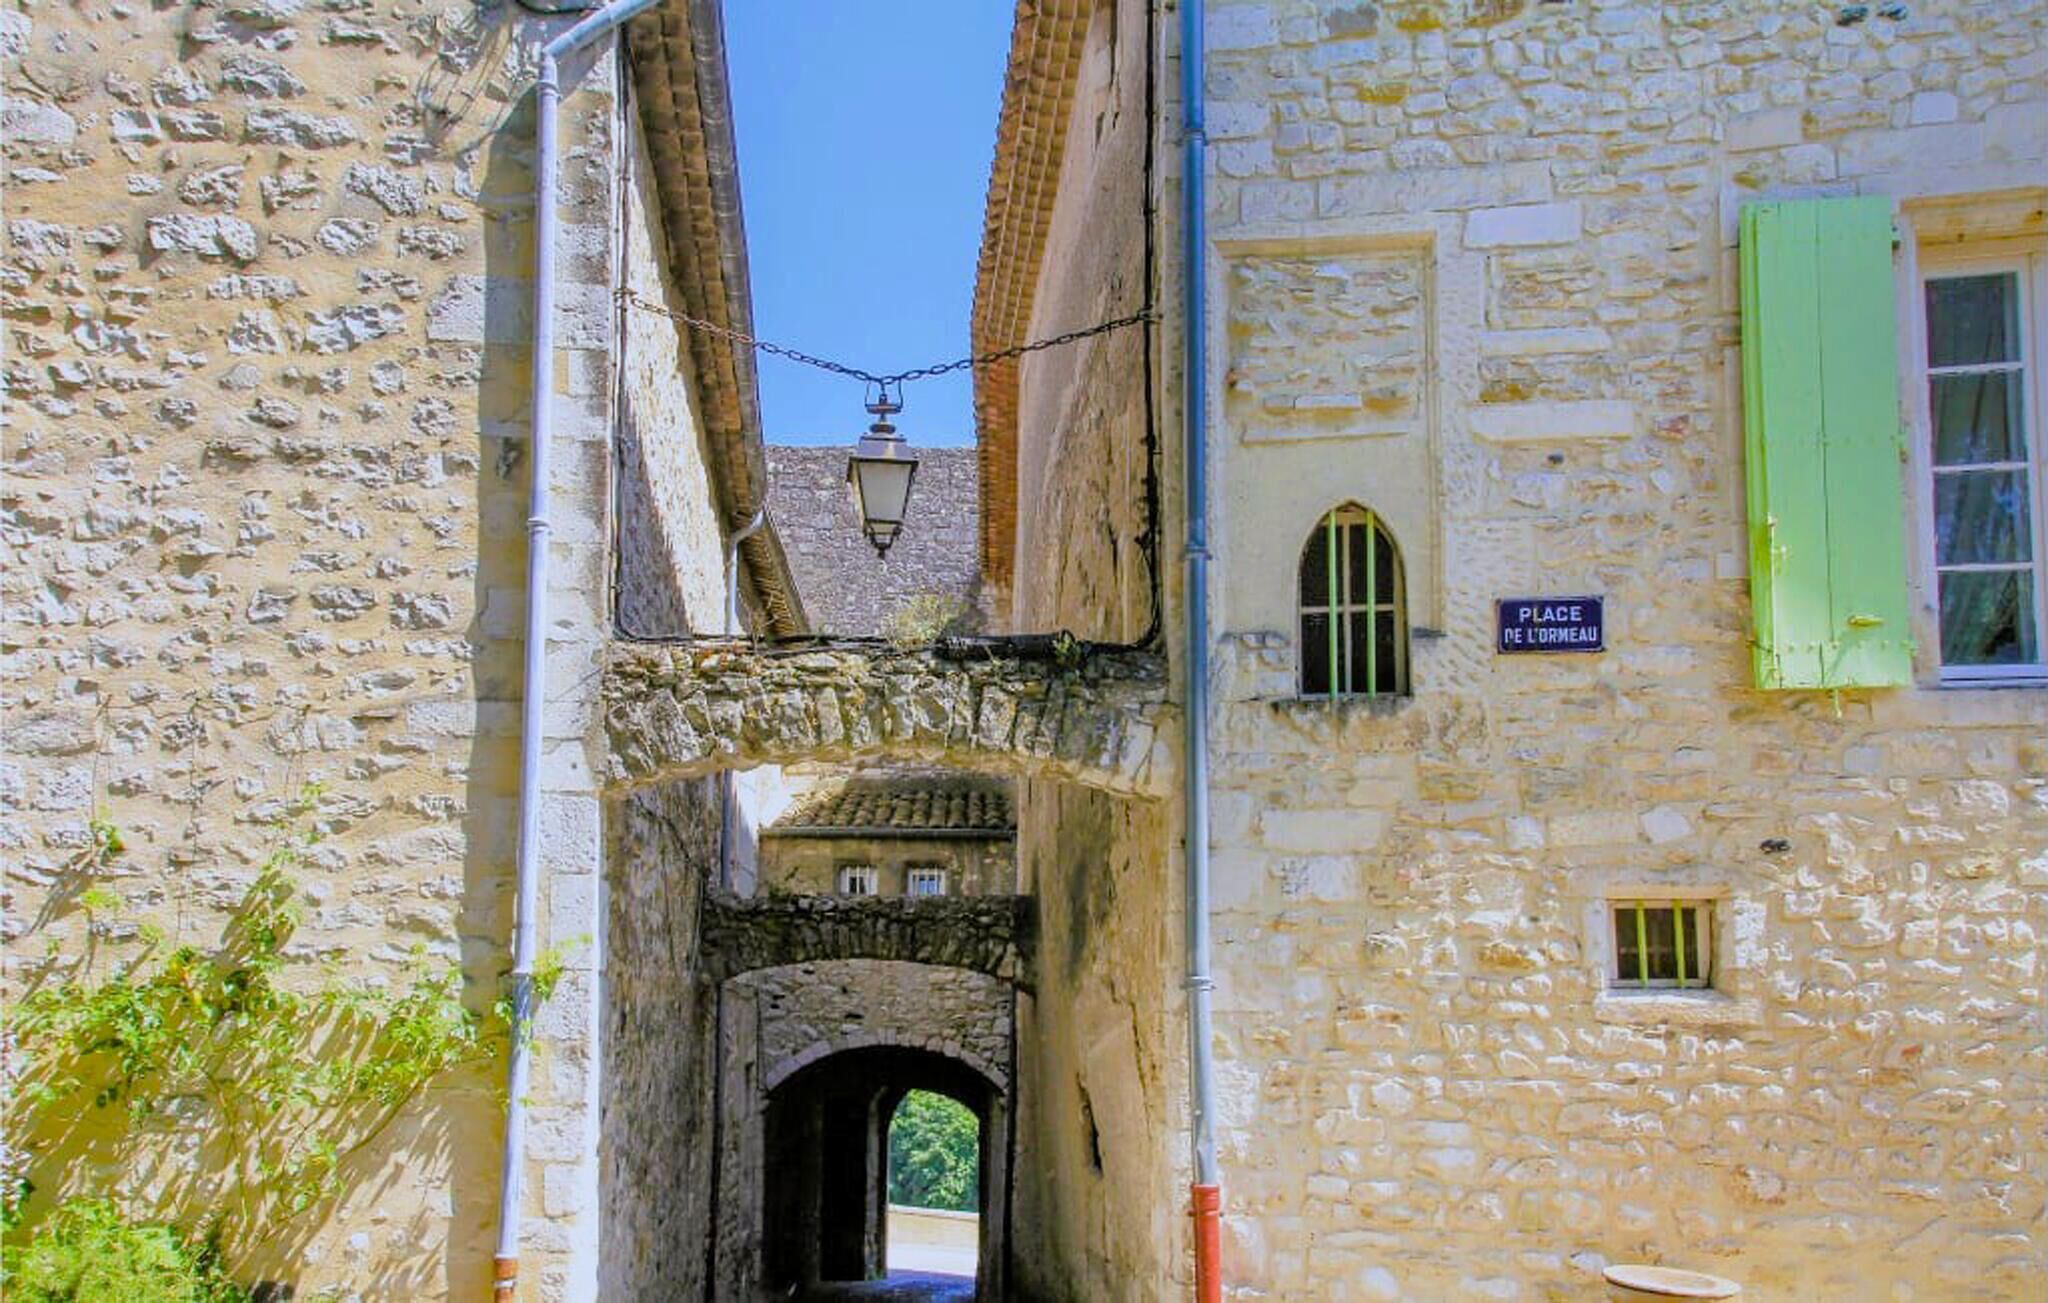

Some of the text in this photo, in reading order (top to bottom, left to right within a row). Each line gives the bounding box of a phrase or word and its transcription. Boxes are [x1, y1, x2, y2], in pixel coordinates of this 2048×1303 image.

[1519, 606, 1583, 623] PLACE
[1504, 626, 1597, 644] DE L'ORMEAU
